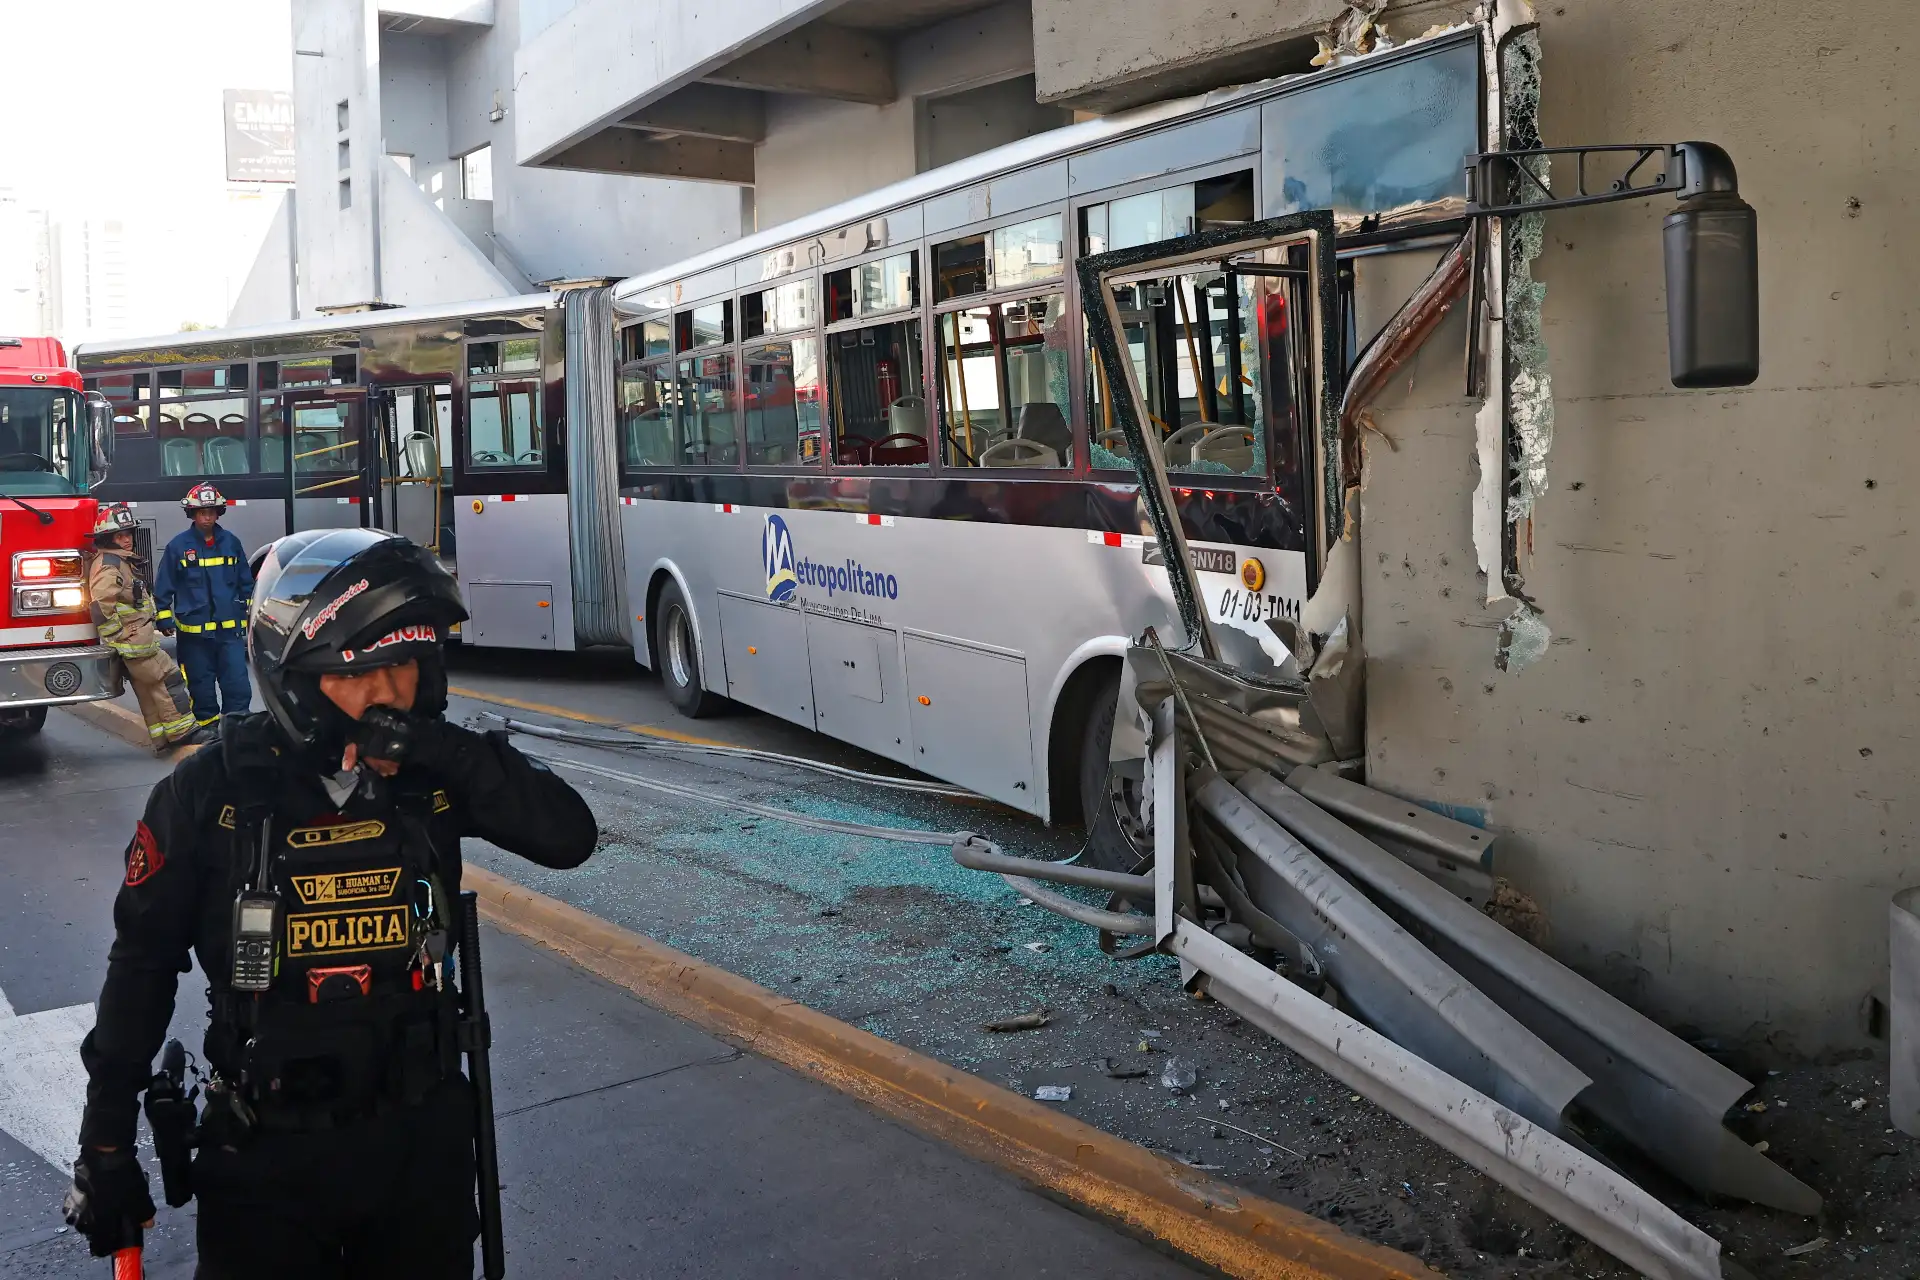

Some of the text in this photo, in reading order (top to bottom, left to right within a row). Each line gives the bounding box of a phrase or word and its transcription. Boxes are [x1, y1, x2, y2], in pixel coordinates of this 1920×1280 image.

[122, 512, 129, 522] 4
[763, 512, 898, 601] Metropolitano
[301, 578, 369, 640] Emergencias
[45, 627, 55, 641] 4
[304, 882, 314, 896] O
[336, 874, 391, 889] J. HUAMAN C.
[291, 913, 405, 950] POLICIA
